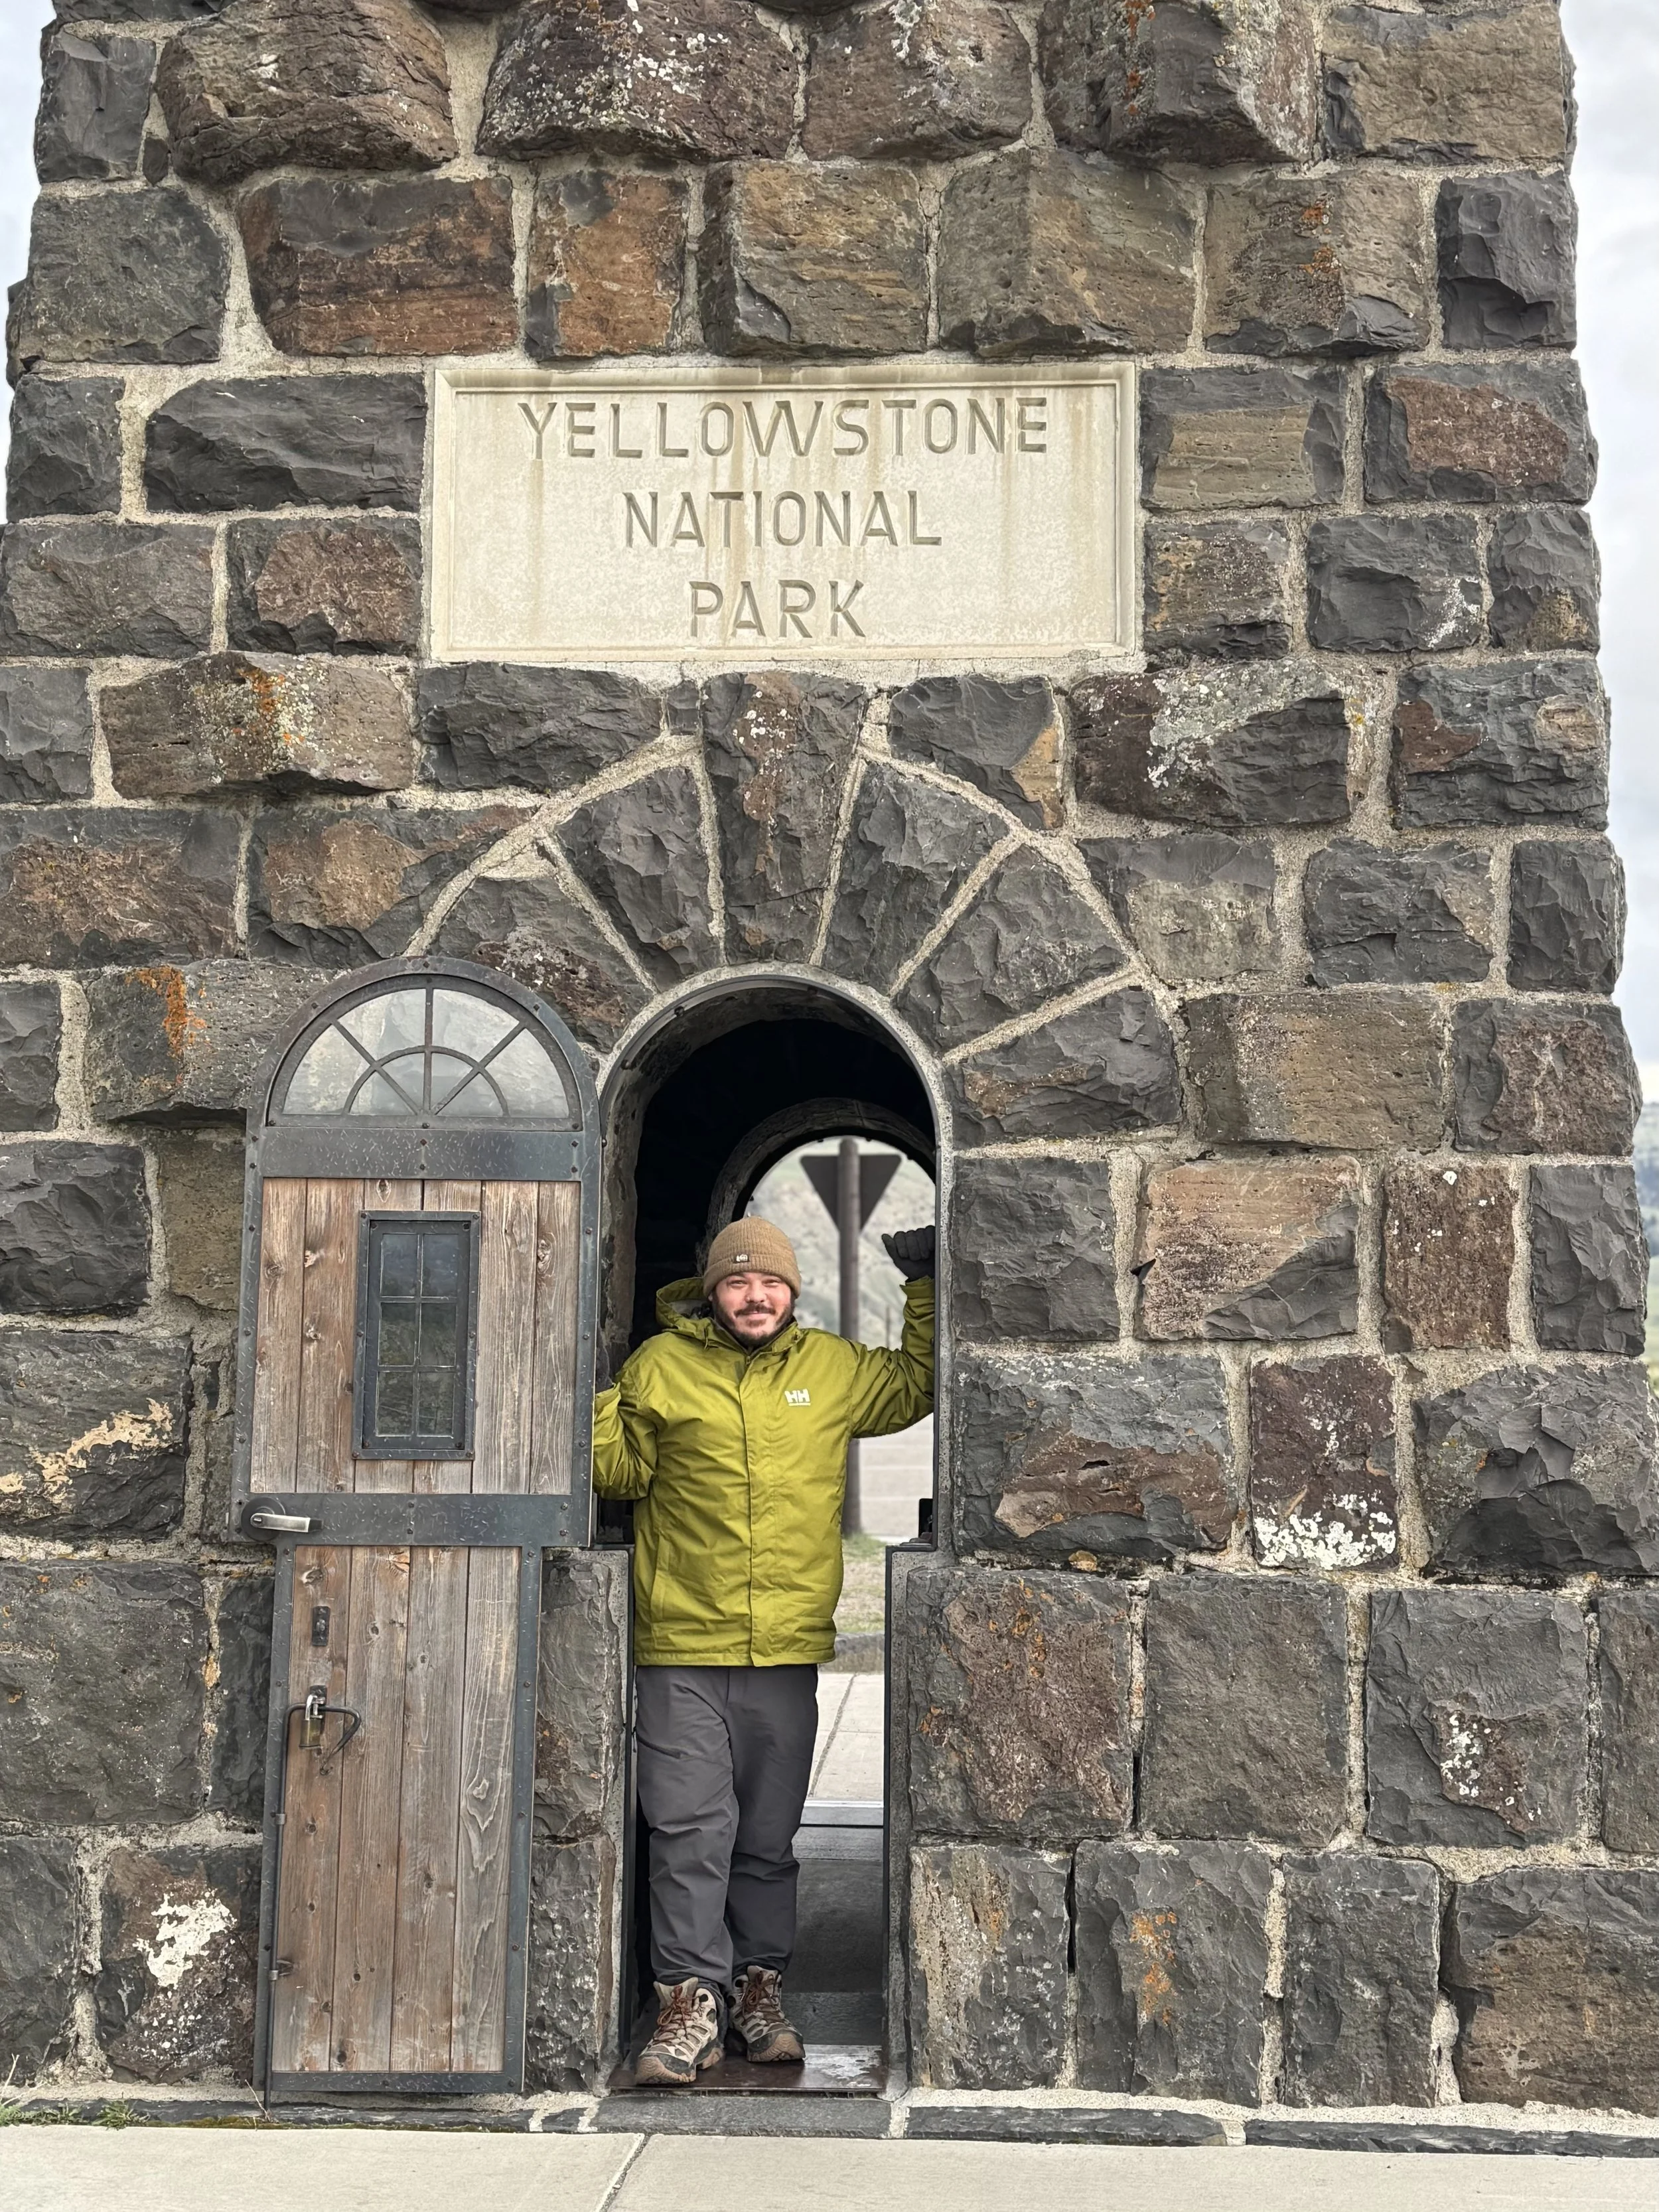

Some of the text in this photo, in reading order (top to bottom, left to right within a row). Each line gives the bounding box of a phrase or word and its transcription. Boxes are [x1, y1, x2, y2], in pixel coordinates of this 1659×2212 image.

[518, 398, 1048, 459] YELLOWSTONE
[624, 490, 942, 548] NATIONAL
[689, 579, 865, 638] PARK
[784, 1388, 810, 1404] HH
